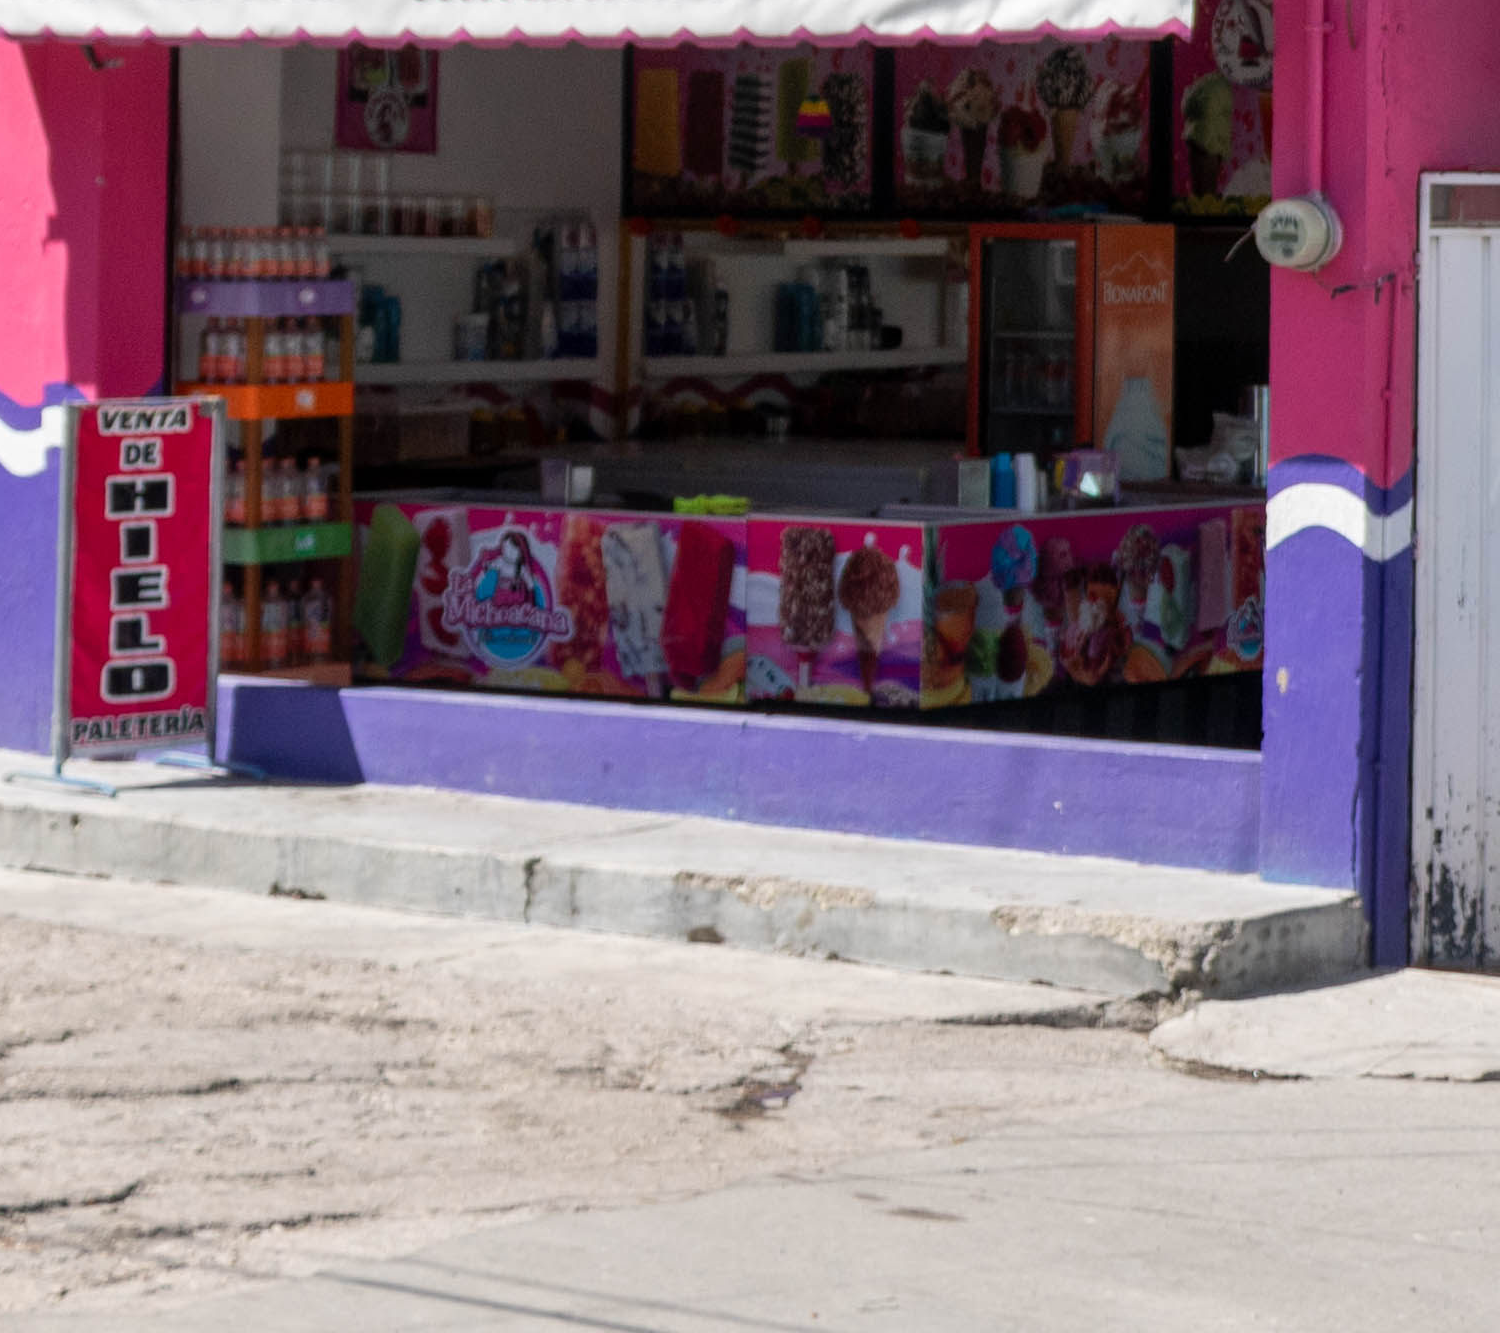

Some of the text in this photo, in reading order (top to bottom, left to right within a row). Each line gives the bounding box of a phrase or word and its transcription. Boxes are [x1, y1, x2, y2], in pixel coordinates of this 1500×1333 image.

[1103, 275, 1168, 305] BONAFONT
[99, 405, 191, 433] VENTA
[121, 439, 161, 470] DE
[102, 475, 173, 702] HIELO
[72, 706, 205, 742] PALETERÍA
